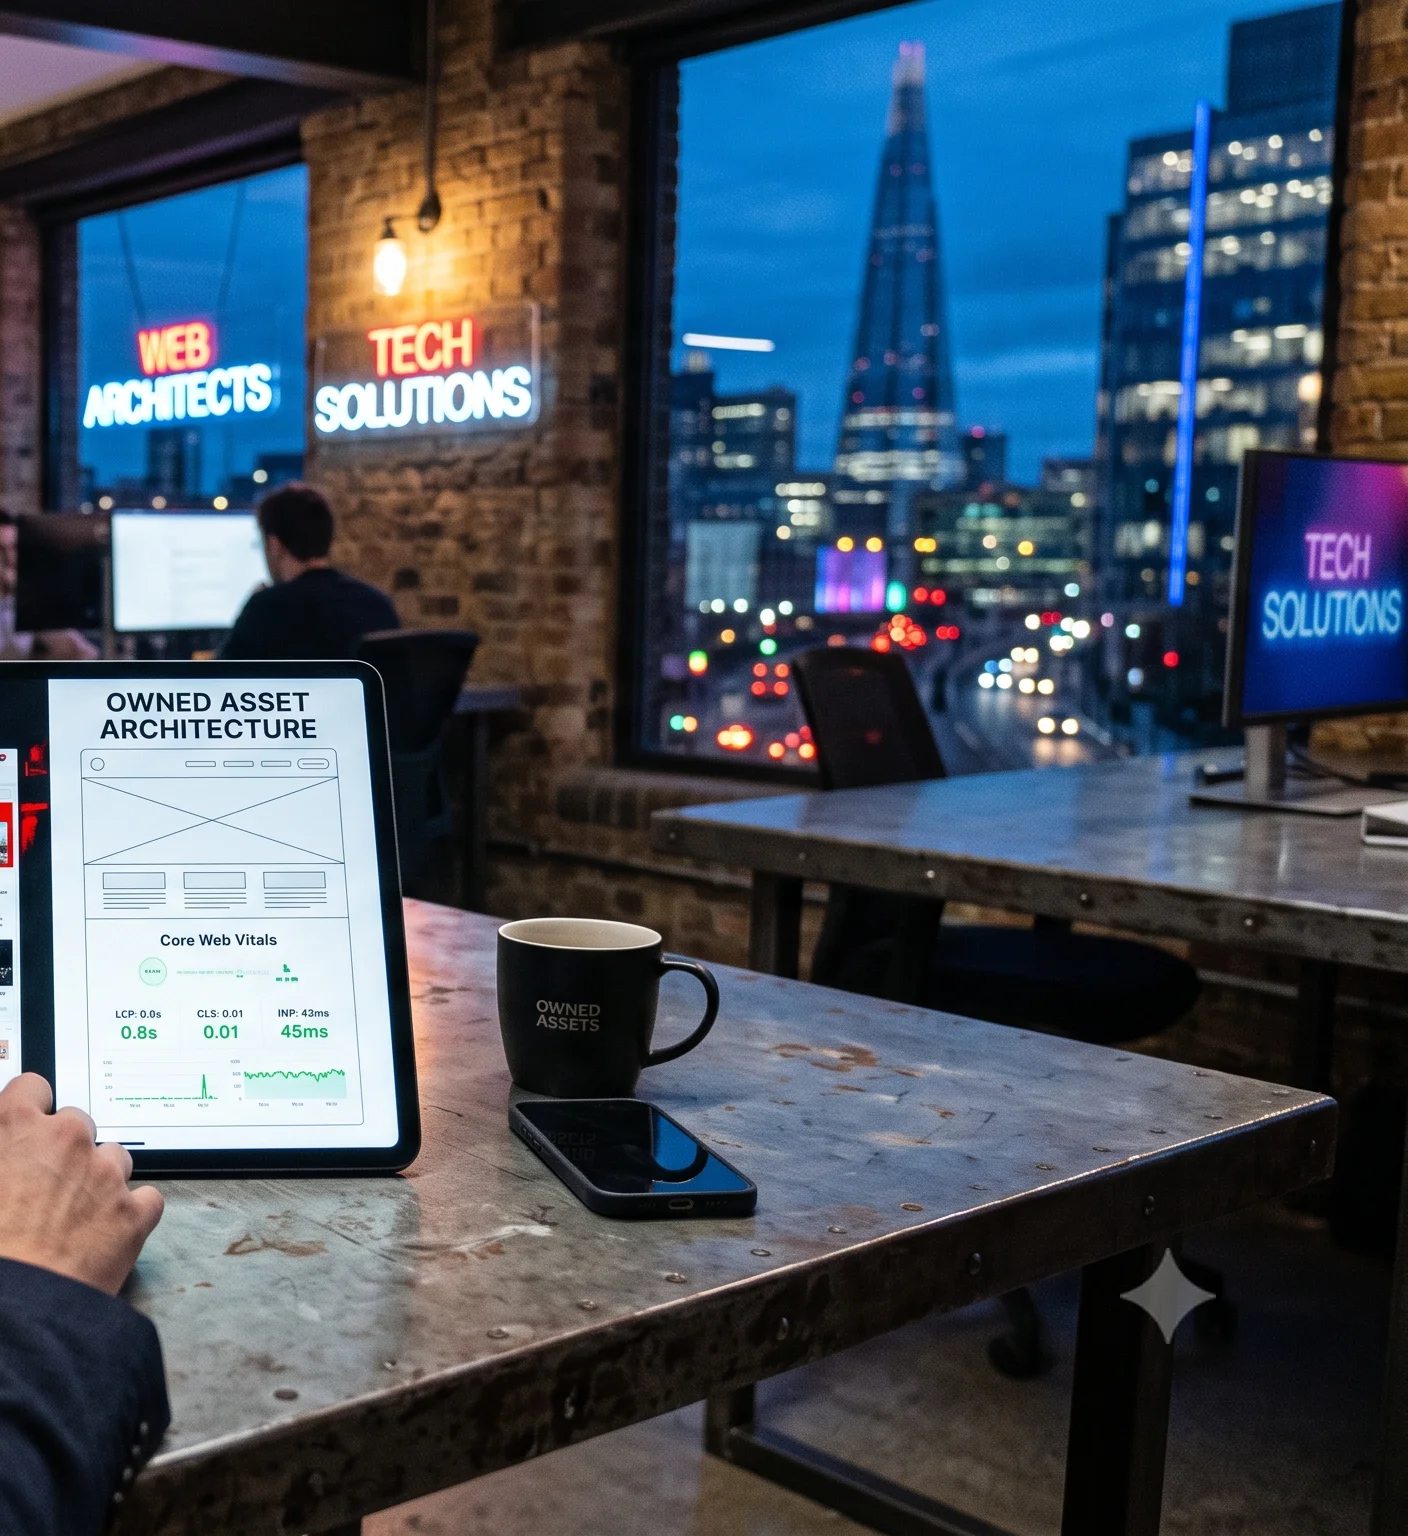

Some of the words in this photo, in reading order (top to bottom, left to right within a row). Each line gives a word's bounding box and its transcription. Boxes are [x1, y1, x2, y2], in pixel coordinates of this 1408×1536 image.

[137, 322, 210, 373] WEB
[368, 319, 474, 376] TECH
[83, 363, 273, 428] ARCHITECTS
[314, 366, 532, 433] SOLUTIONS
[1305, 532, 1371, 581] TECH
[1262, 589, 1402, 639] SOLUTIONS
[107, 692, 211, 712] OWNED
[220, 692, 309, 712] ASSET
[100, 719, 317, 739] ARCHITECTURE
[160, 934, 195, 946] Core
[199, 934, 231, 946] Web
[235, 933, 277, 946] Vitals
[115, 1010, 137, 1019] LCP:
[140, 1010, 162, 1019] 0.0s
[197, 1009, 220, 1018] CLS:
[222, 1009, 243, 1018] 0.01
[278, 1009, 298, 1018] INP:
[301, 1009, 329, 1018] 43ms
[536, 999, 601, 1017] OWNED
[121, 1025, 157, 1039] 0.8s
[204, 1025, 238, 1039] 0.01
[281, 1025, 328, 1038] 45ms
[536, 1014, 600, 1032] ASSETS
